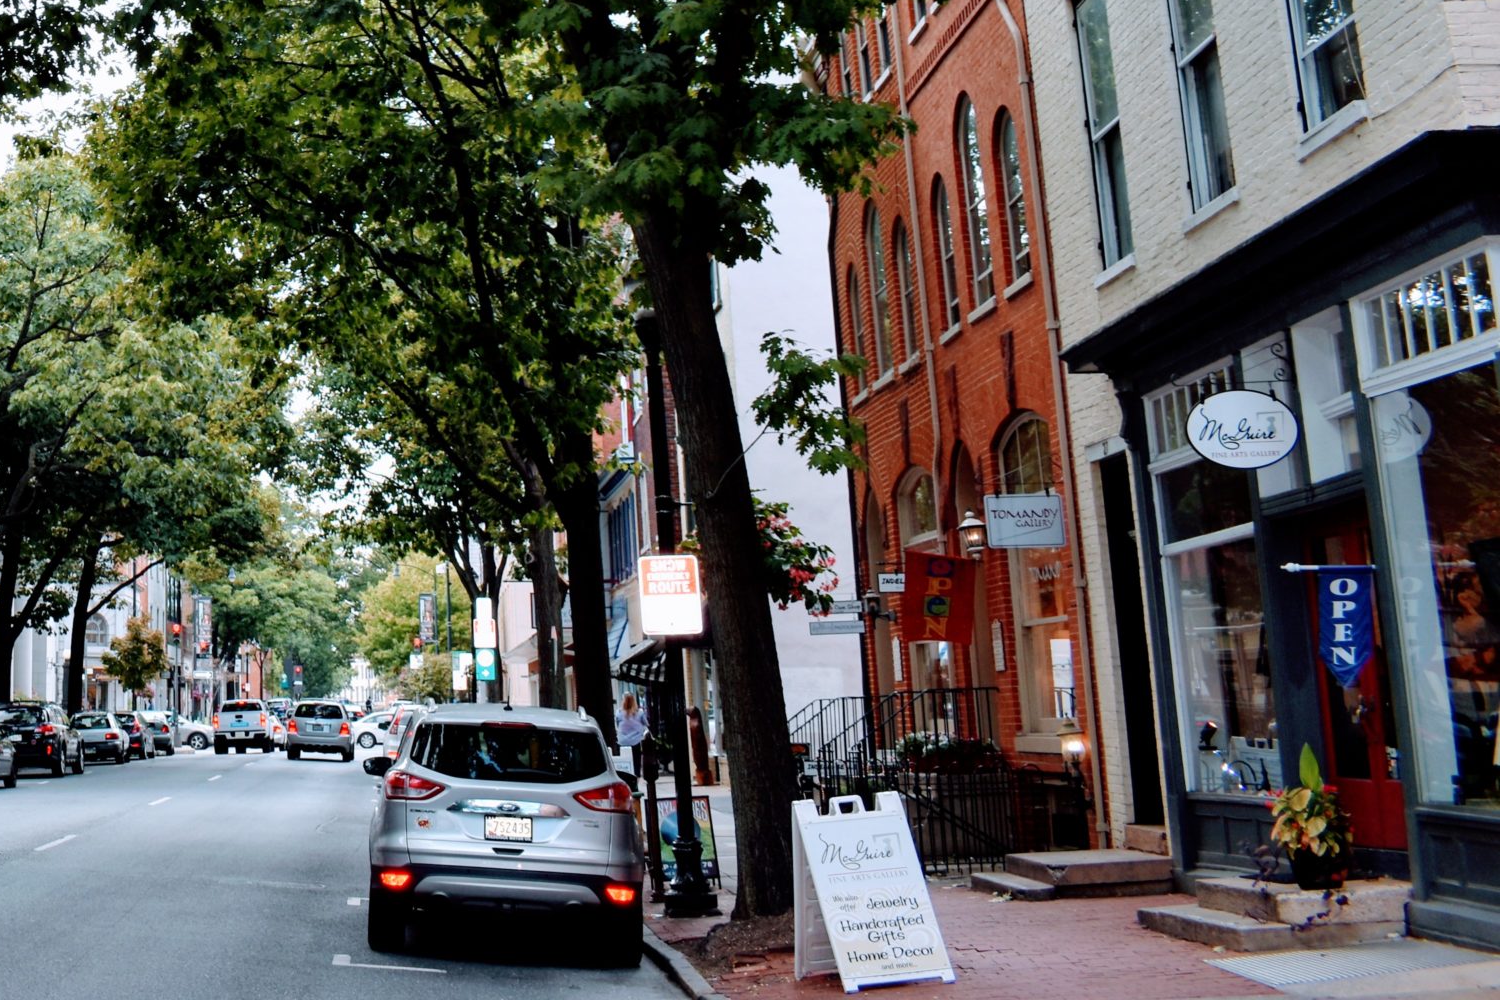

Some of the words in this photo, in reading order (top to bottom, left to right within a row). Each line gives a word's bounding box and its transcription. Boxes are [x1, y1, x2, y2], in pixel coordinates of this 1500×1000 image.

[1199, 408, 1276, 450] McGuire
[648, 581, 690, 594] ROUTE
[1329, 578, 1358, 665] OPEN
[818, 833, 893, 870] McGuire
[866, 896, 919, 910] Jewelry
[840, 914, 924, 932] Handcrafted
[867, 930, 905, 946] Gifts
[847, 949, 889, 963] Home
[892, 946, 934, 959] Decor
[881, 962, 894, 970] and
